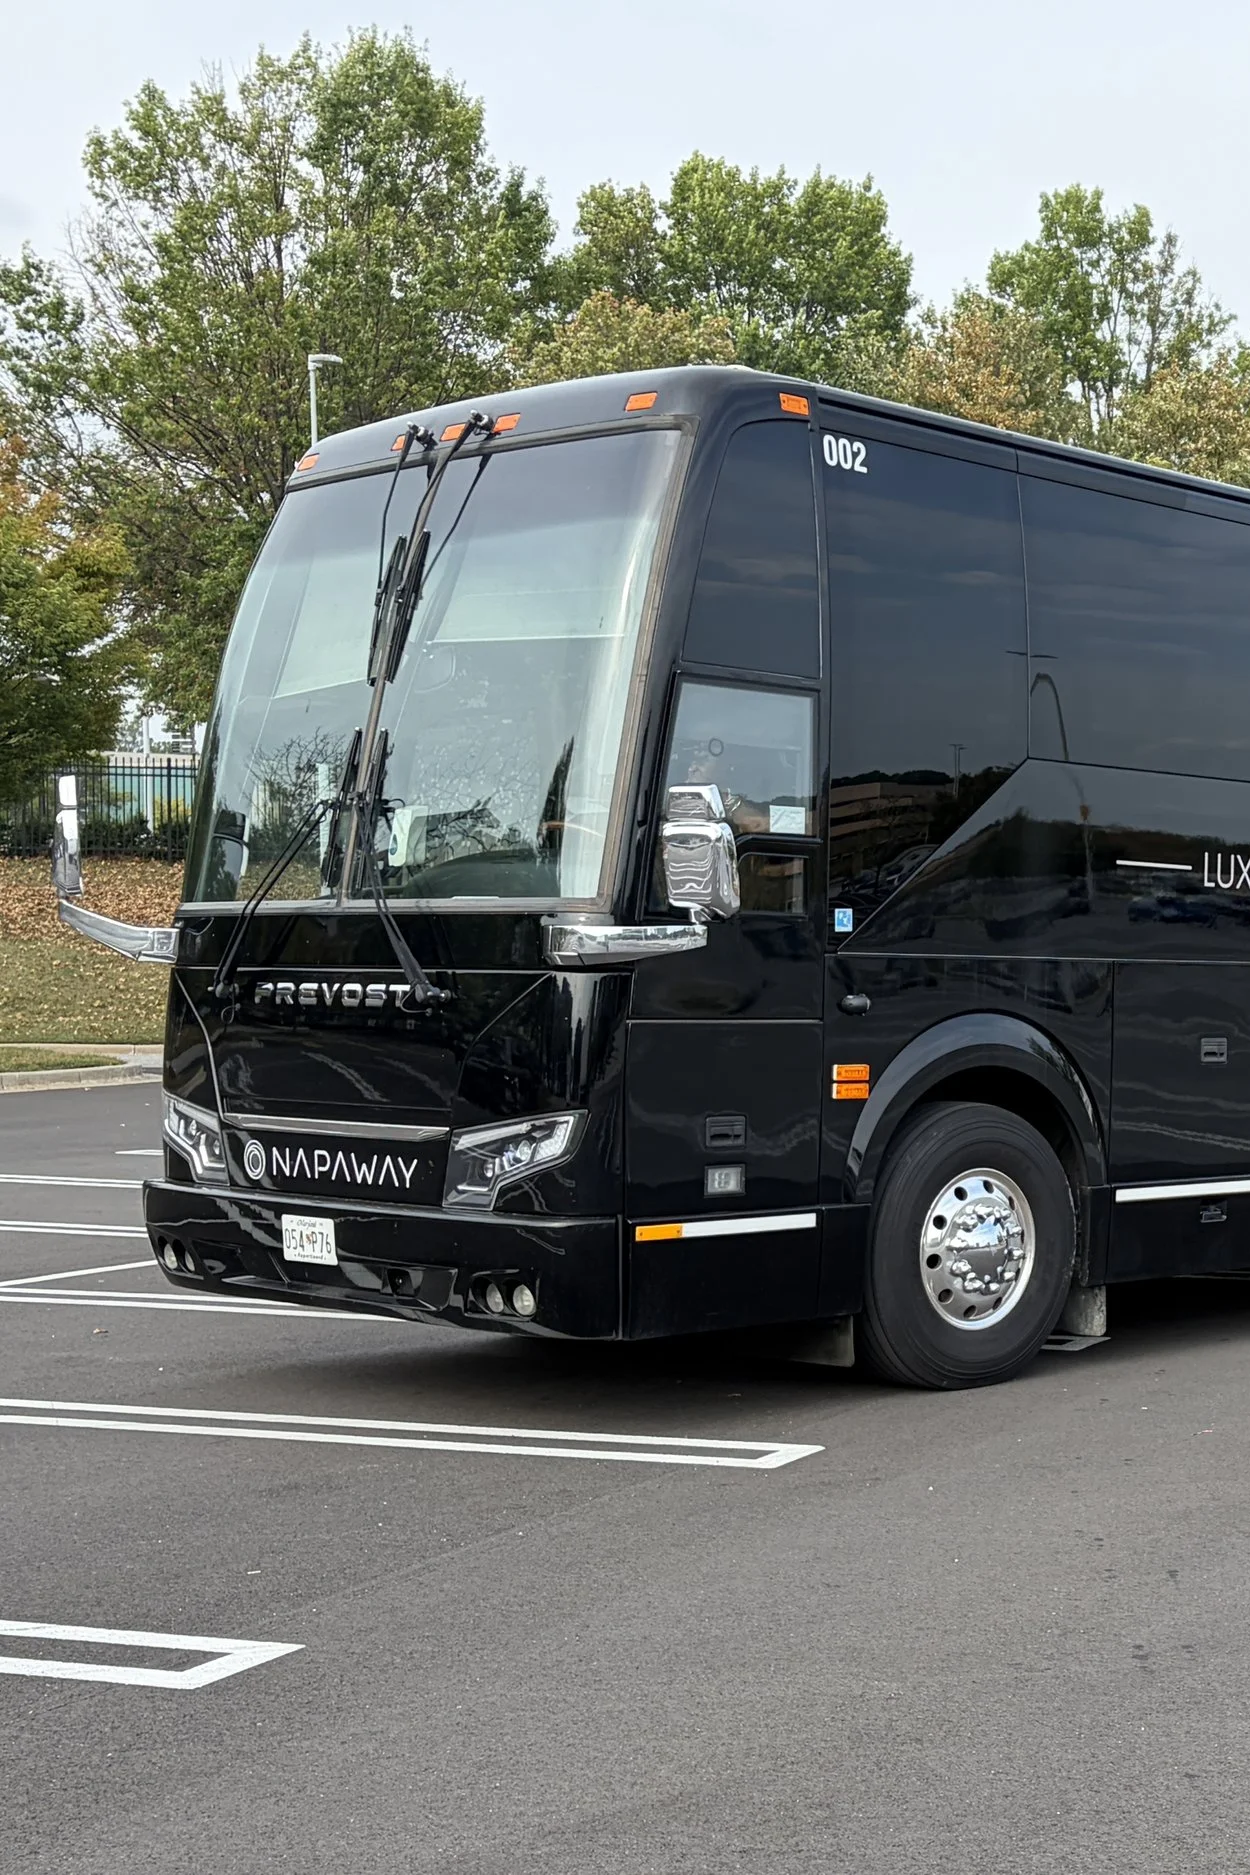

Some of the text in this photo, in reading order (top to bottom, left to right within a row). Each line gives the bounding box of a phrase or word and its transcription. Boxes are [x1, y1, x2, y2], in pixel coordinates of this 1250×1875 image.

[823, 434, 868, 474] 002
[254, 981, 412, 1008] PREVOST
[271, 1146, 418, 1189] NAPAWAY
